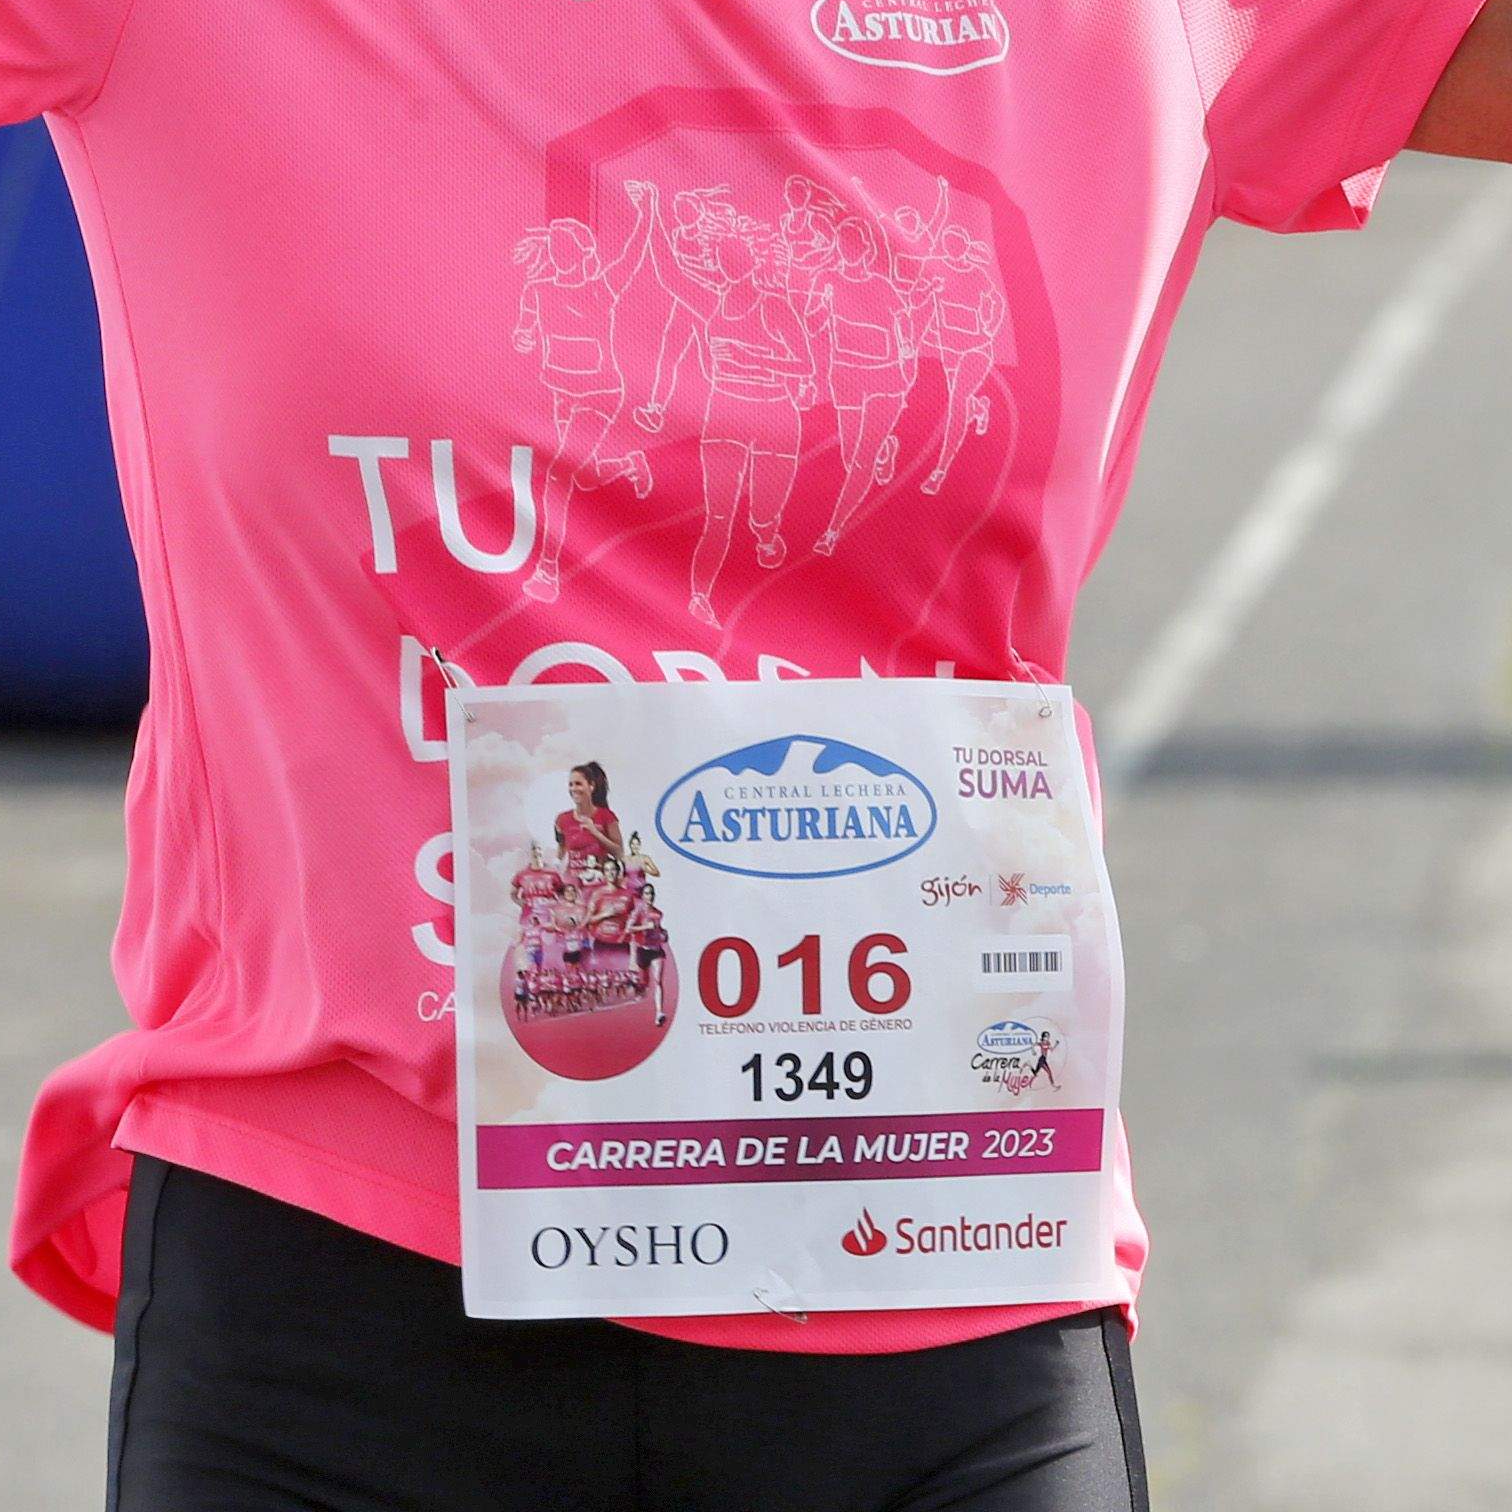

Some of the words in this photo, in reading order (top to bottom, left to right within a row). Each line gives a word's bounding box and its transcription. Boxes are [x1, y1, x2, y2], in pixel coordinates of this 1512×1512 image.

[832, 0, 1001, 45] ASTURIAN
[328, 434, 537, 575] TU
[953, 746, 973, 764] TU
[977, 748, 1048, 767] DORSAL
[724, 784, 812, 801] CENTRAL
[821, 784, 907, 799] LECHERA
[958, 767, 1053, 800] SUMA
[679, 790, 919, 842] ASTURIANA
[920, 874, 983, 907] gijón
[1028, 882, 1072, 899] Deporte
[698, 933, 912, 1019] 016
[699, 1020, 765, 1036] TELÉFONO
[768, 1020, 836, 1034] VIOLENCIA
[839, 1019, 857, 1032] DE
[859, 1017, 913, 1032] GÉNERO
[742, 1050, 874, 1102] 1349
[970, 1052, 1021, 1071] Carrera
[998, 1070, 1036, 1097] Mujer
[545, 1137, 726, 1172] CARRERA
[735, 1137, 788, 1167] DE
[795, 1135, 845, 1165] LA
[852, 1130, 970, 1163] MUJER
[981, 1127, 1055, 1158] 2023
[531, 1221, 730, 1269] OYSHO
[895, 1213, 1068, 1255] Santander
